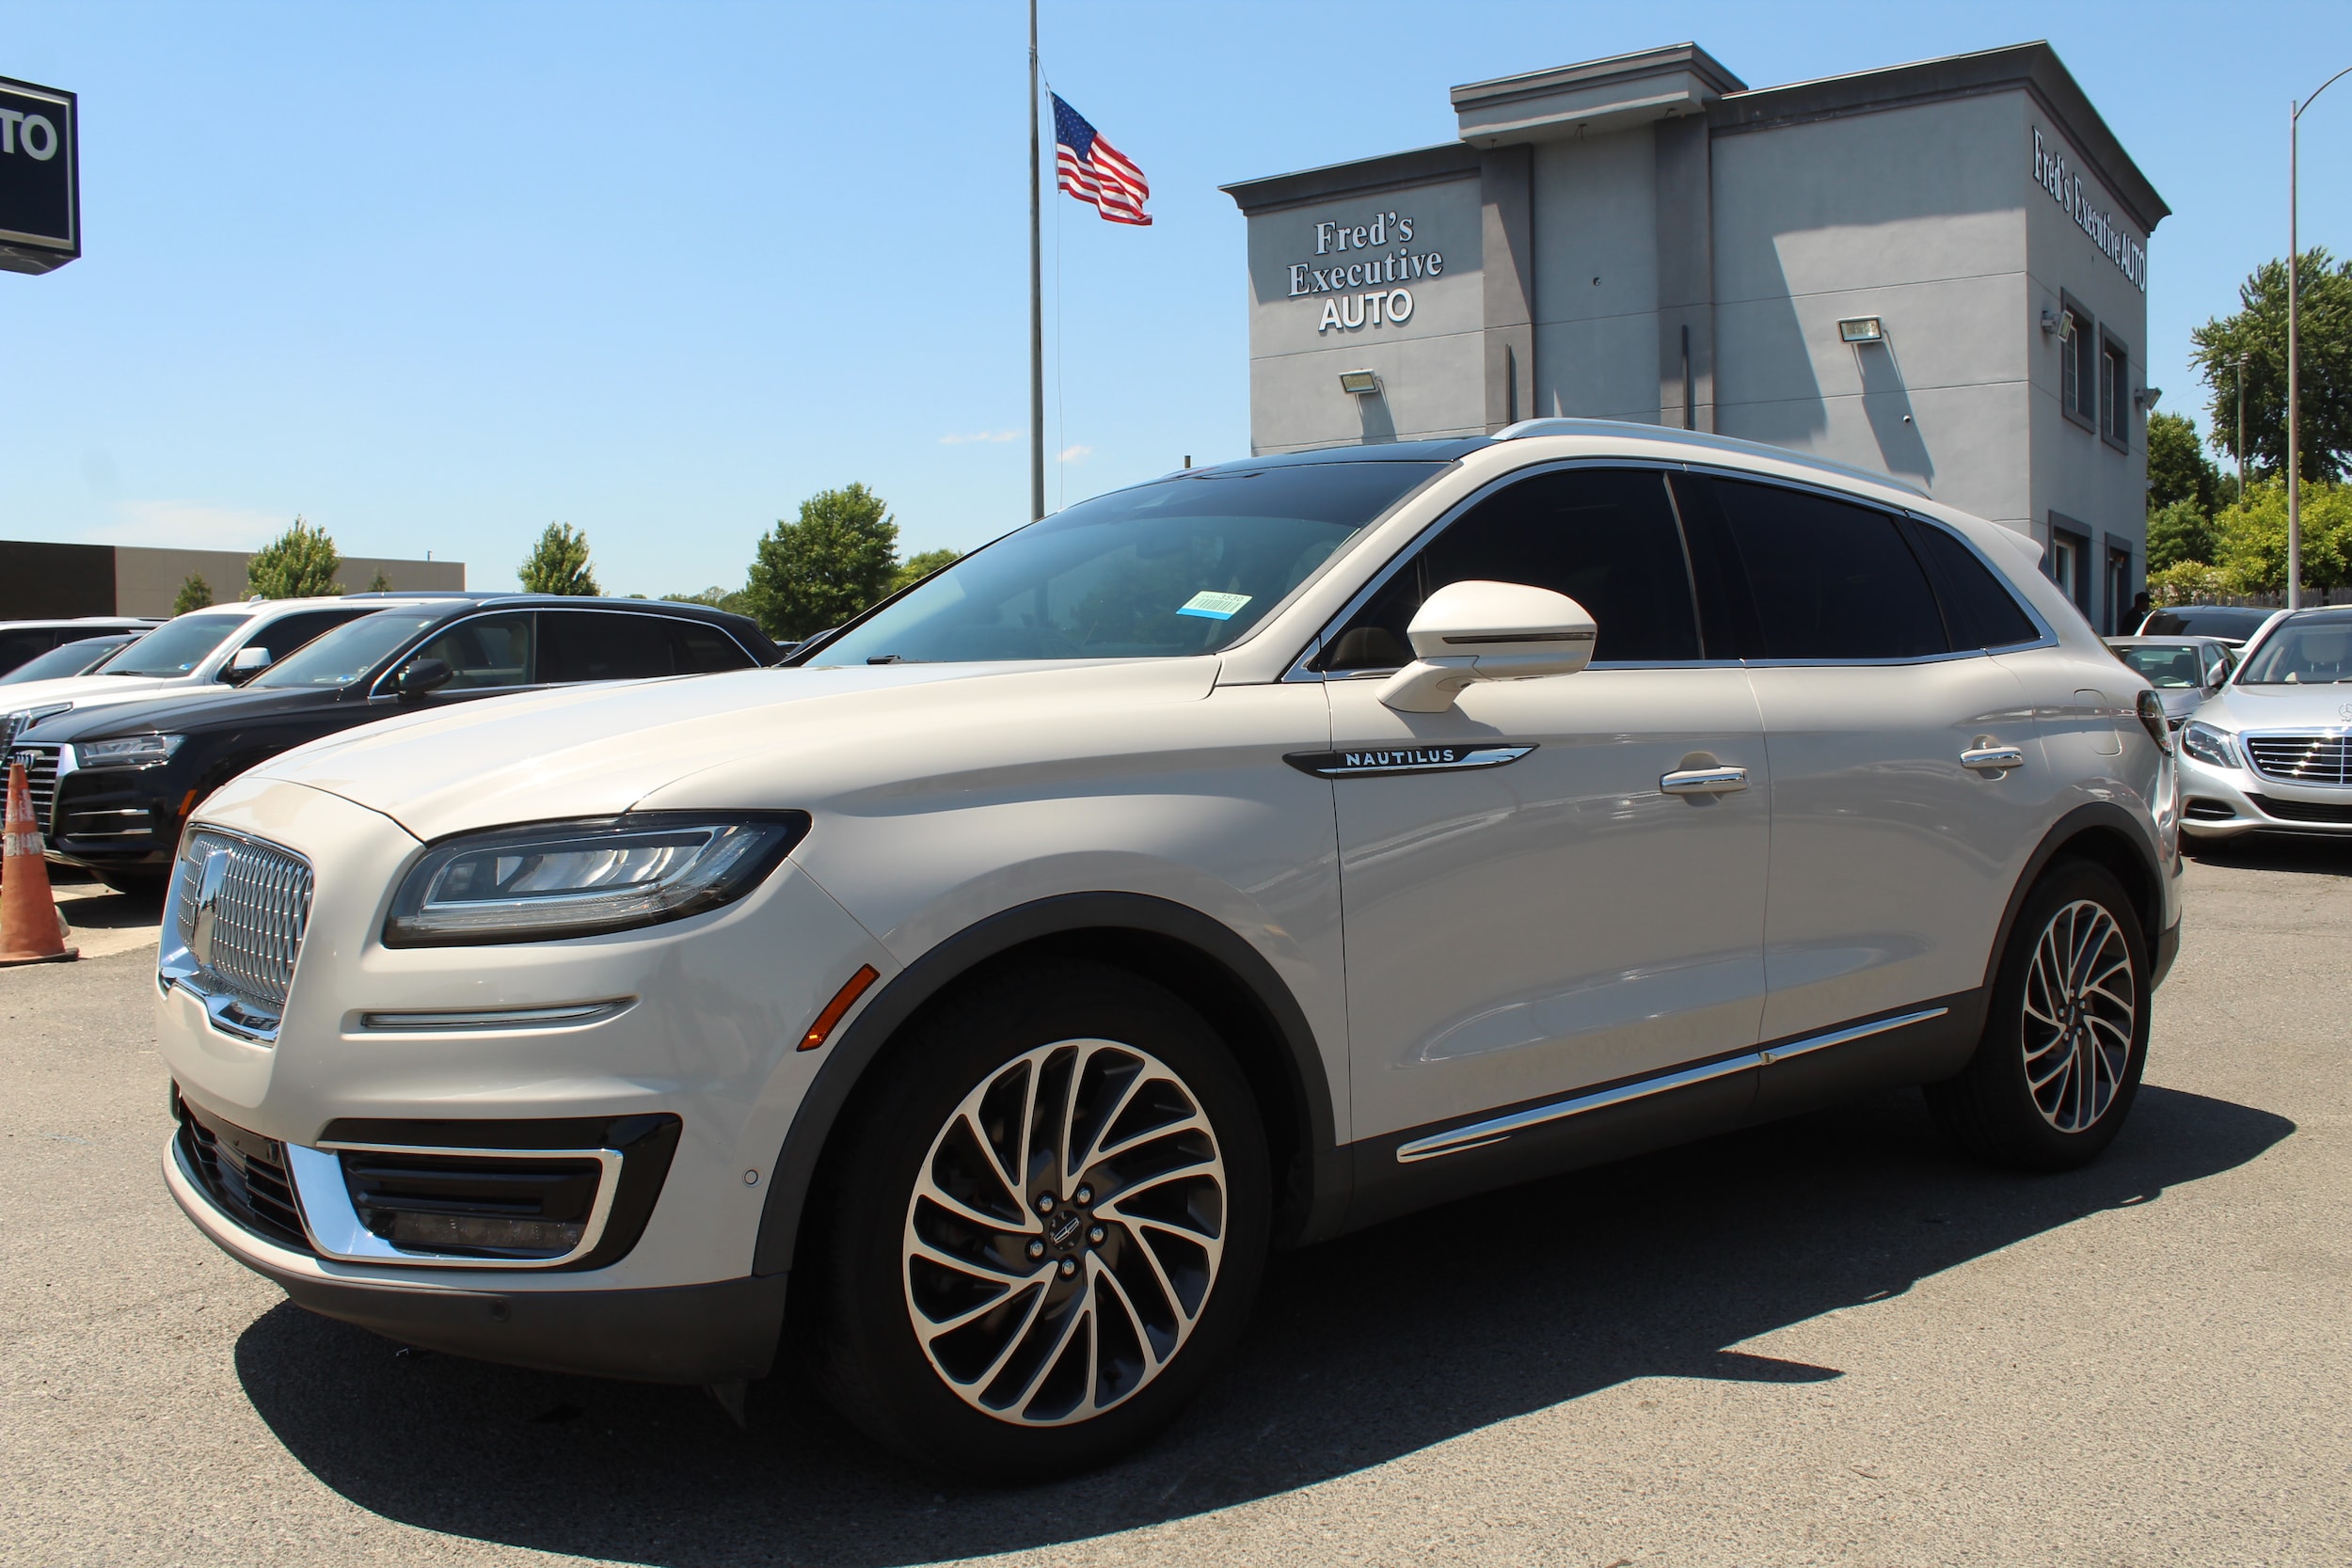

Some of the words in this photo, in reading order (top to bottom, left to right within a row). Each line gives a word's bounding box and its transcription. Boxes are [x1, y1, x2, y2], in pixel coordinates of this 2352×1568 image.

[2032, 126, 2070, 214] Fred's
[2073, 172, 2120, 266] Executive
[2121, 230, 2146, 293] AUTO
[1314, 211, 1414, 256] Fred's
[1287, 247, 1442, 297] Executive
[1318, 287, 1413, 332] AUTO
[1346, 750, 1454, 767] NAUTILUS
